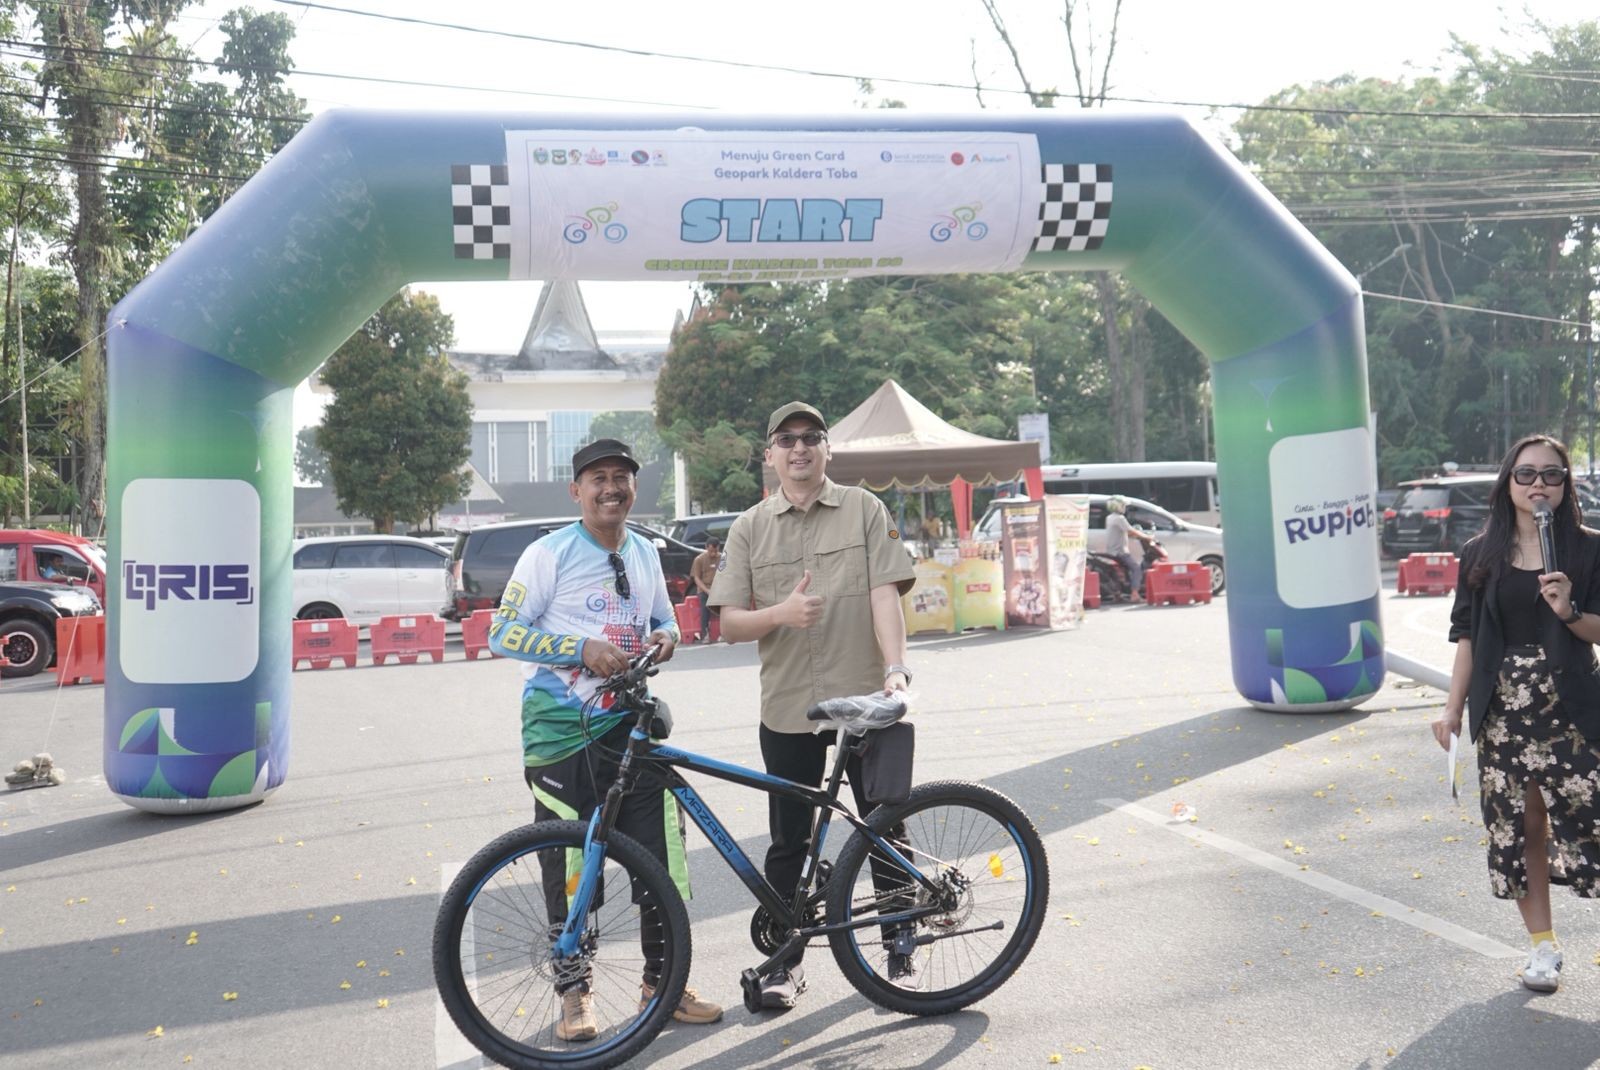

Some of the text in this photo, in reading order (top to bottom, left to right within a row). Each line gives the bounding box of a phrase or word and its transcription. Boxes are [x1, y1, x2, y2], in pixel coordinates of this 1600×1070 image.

[721, 150, 845, 163] Menuju Green Card
[714, 167, 858, 181] Geopark Kaldera Toba
[680, 197, 883, 243] START
[732, 257, 818, 270] KALDERA
[822, 257, 873, 269] TOBA
[124, 562, 251, 611] QRIS
[681, 788, 734, 853] MAZARA
